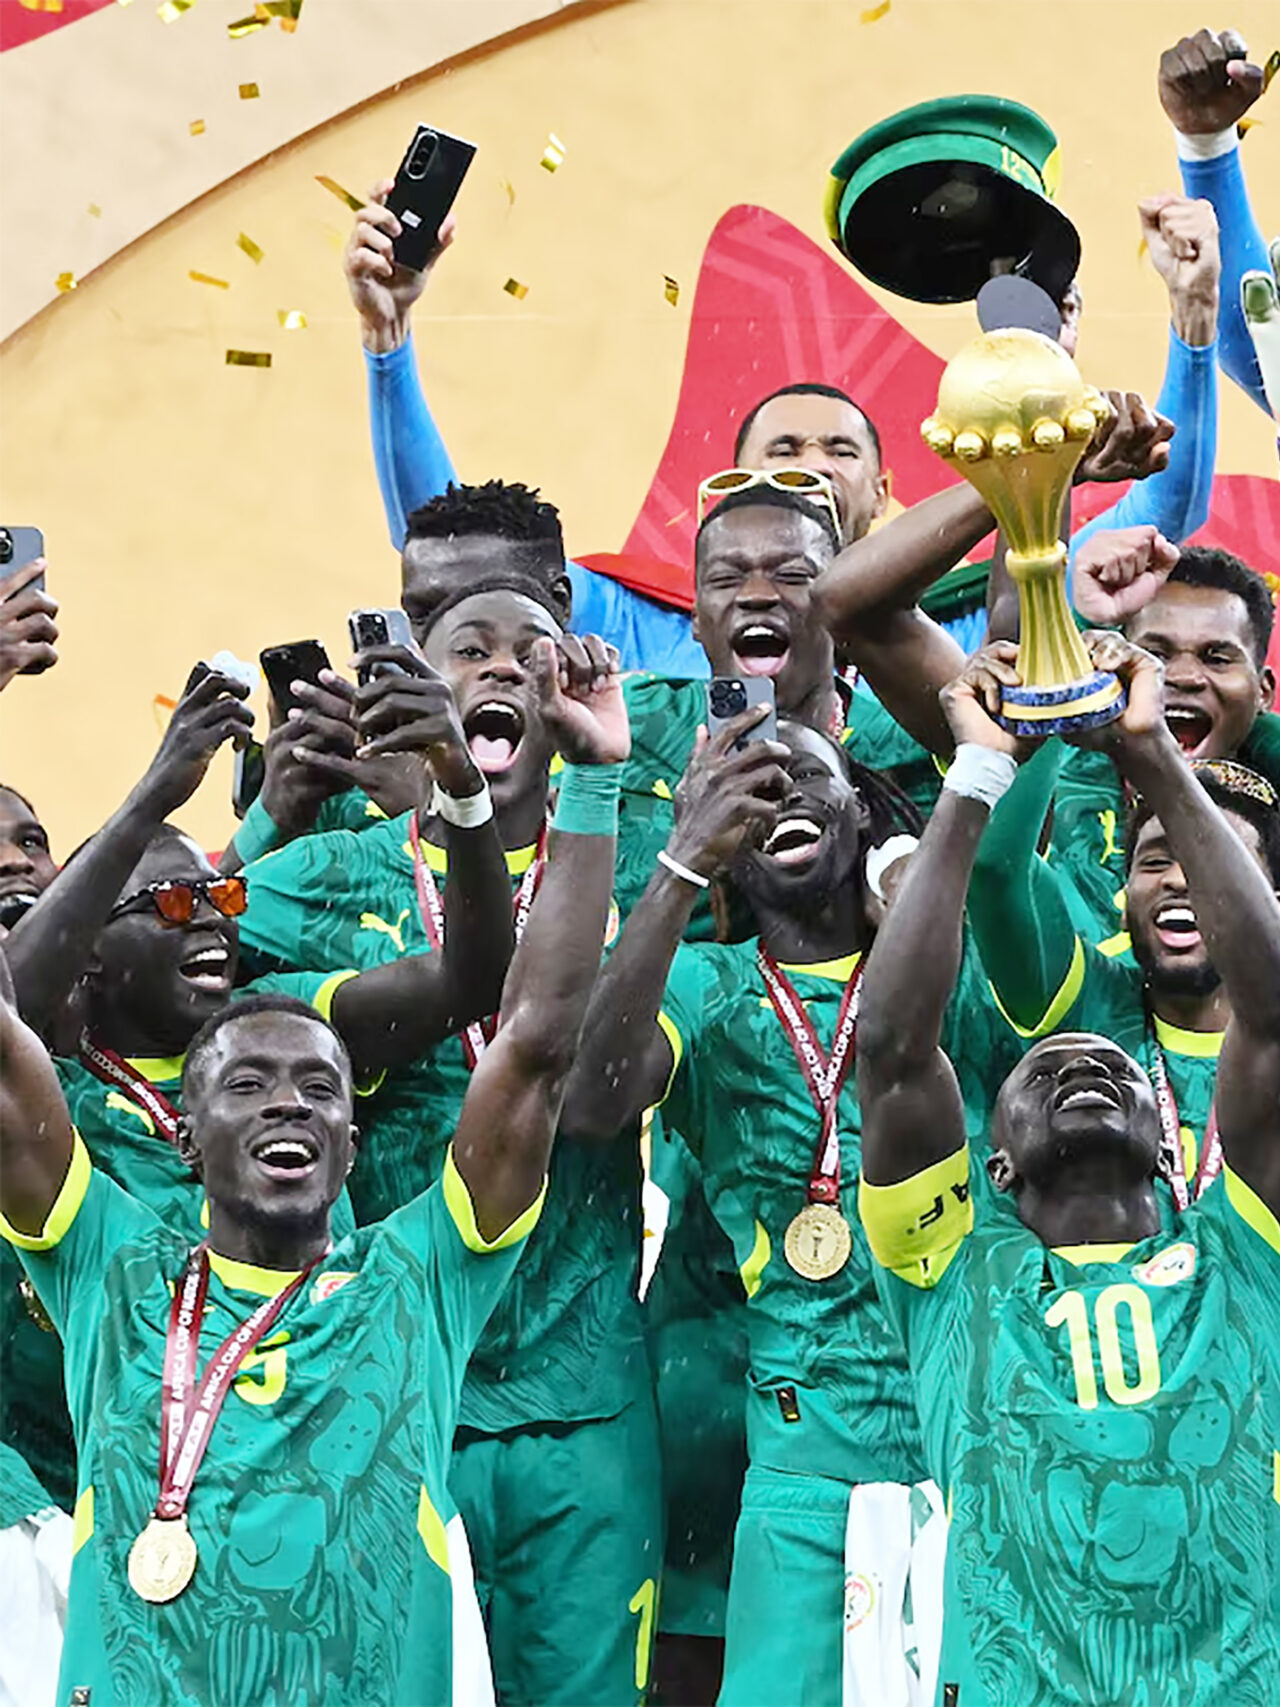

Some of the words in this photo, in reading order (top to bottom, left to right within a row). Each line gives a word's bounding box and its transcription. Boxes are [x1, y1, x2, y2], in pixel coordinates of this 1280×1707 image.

[200, 1364, 230, 1410] AFRICA
[221, 1341, 241, 1365] CUP
[236, 1326, 252, 1343] OF
[1044, 1283, 1161, 1410] 10
